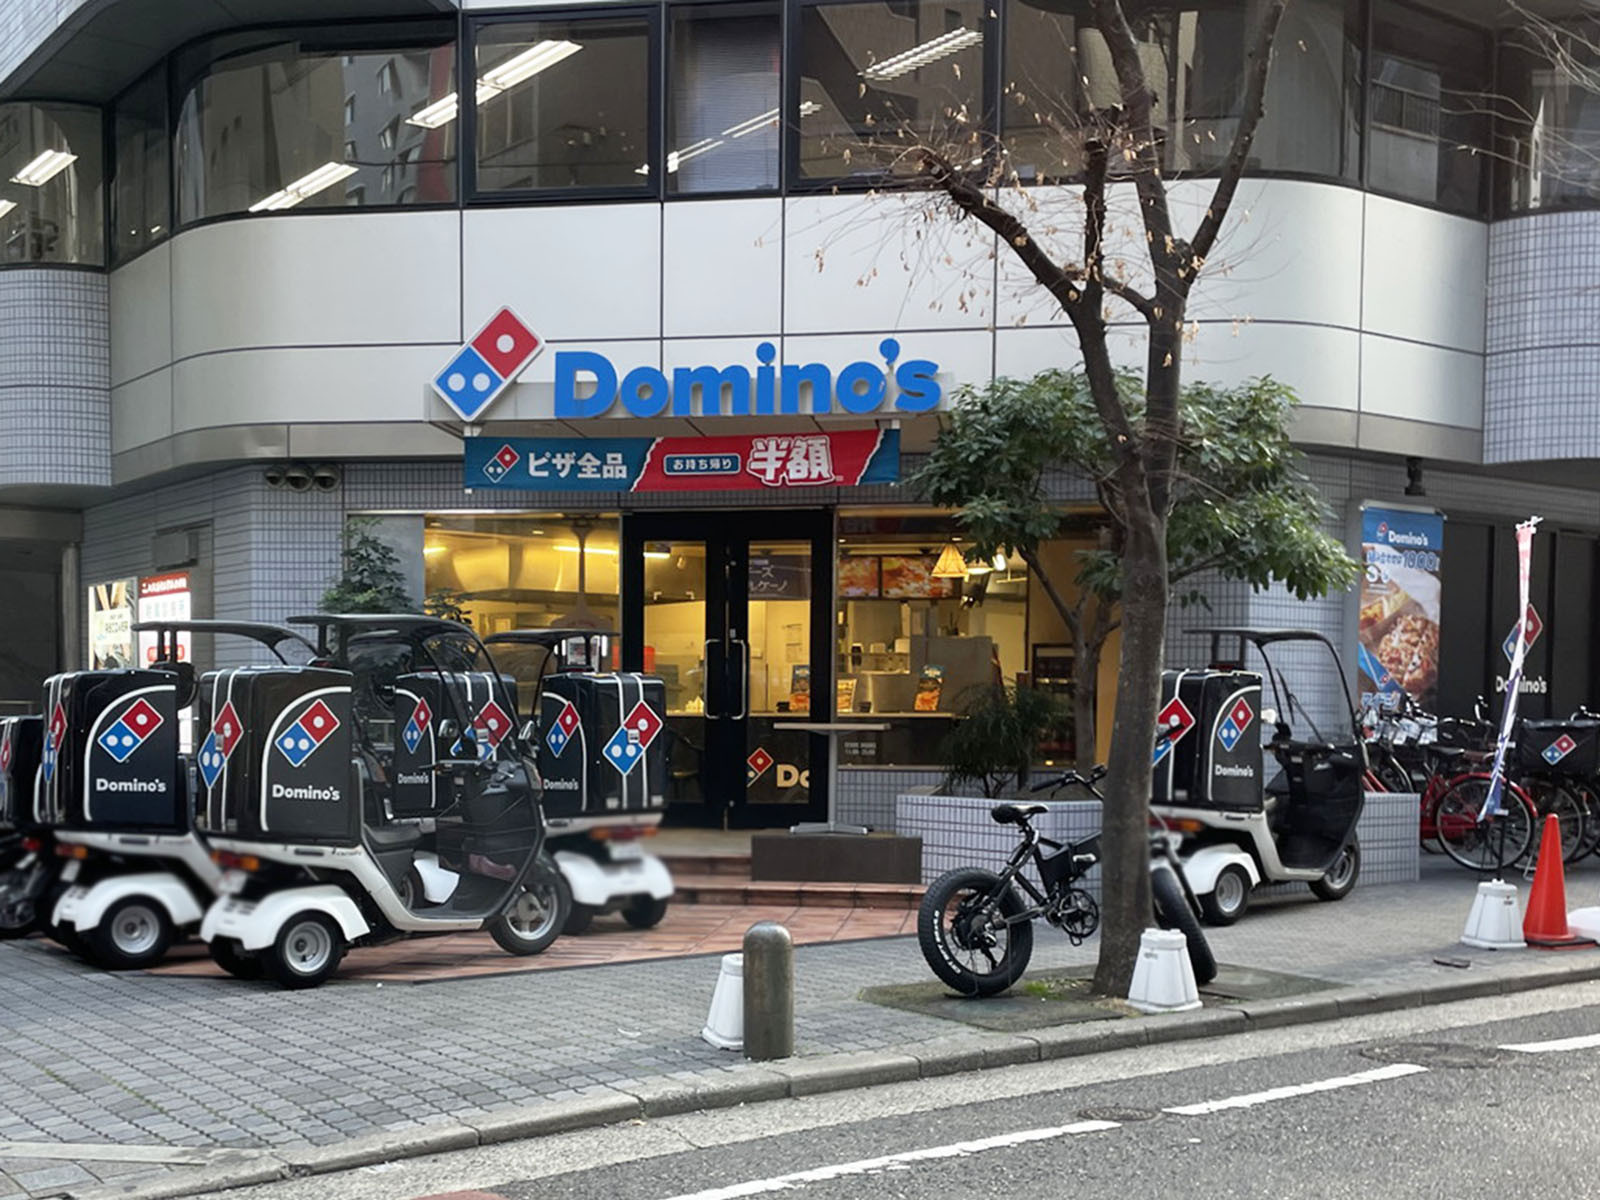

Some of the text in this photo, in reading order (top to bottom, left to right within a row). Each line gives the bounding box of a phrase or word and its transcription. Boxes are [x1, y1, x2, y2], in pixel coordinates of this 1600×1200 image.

[554, 338, 942, 419] Domino's
[528, 451, 628, 480] ピザ全品
[673, 458, 733, 472] お持ち帰り
[748, 436, 836, 486] 半額
[1388, 529, 1429, 546] Domino's
[397, 772, 429, 785] Domino's
[1215, 764, 1254, 777] Domino's
[95, 778, 167, 793] Domino's
[272, 784, 341, 801] Domino's
[543, 778, 579, 791] Domino's
